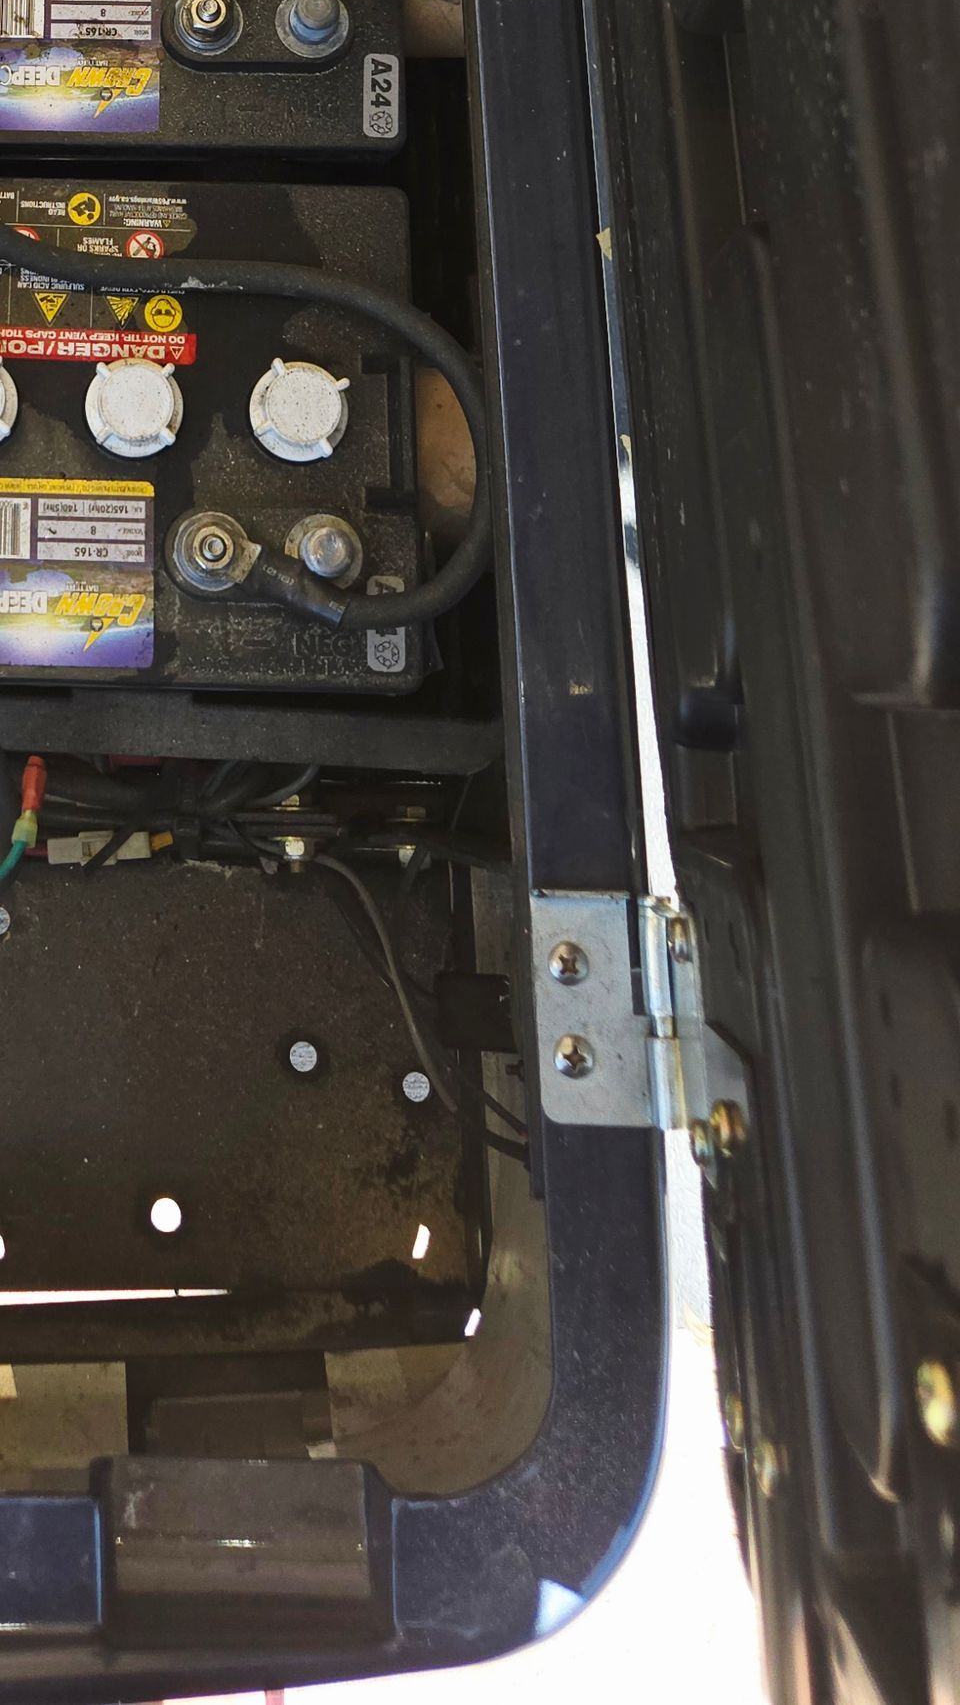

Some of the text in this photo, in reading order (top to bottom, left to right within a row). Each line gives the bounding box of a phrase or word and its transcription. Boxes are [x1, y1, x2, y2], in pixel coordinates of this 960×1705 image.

[101, 8, 106, 17] 8
[85, 27, 117, 37] CR-165
[67, 67, 152, 97] CROWN
[371, 58, 393, 109] A24
[20, 200, 66, 209] INSTRUCTIONS
[123, 218, 162, 228] WARNING:
[83, 237, 113, 245] FLAMES
[77, 244, 119, 253] SPARKS OR
[25, 330, 56, 339] CAPS
[58, 331, 88, 340] VENT
[89, 333, 119, 341] KEEP
[121, 334, 141, 342] TIP.
[144, 335, 166, 343] NOT
[169, 336, 185, 344] DO
[43, 502, 129, 514] 165(20hr) 140(5hr)
[91, 526, 97, 535] 8
[74, 547, 109, 557] CR-165
[54, 592, 146, 627] CROWN
